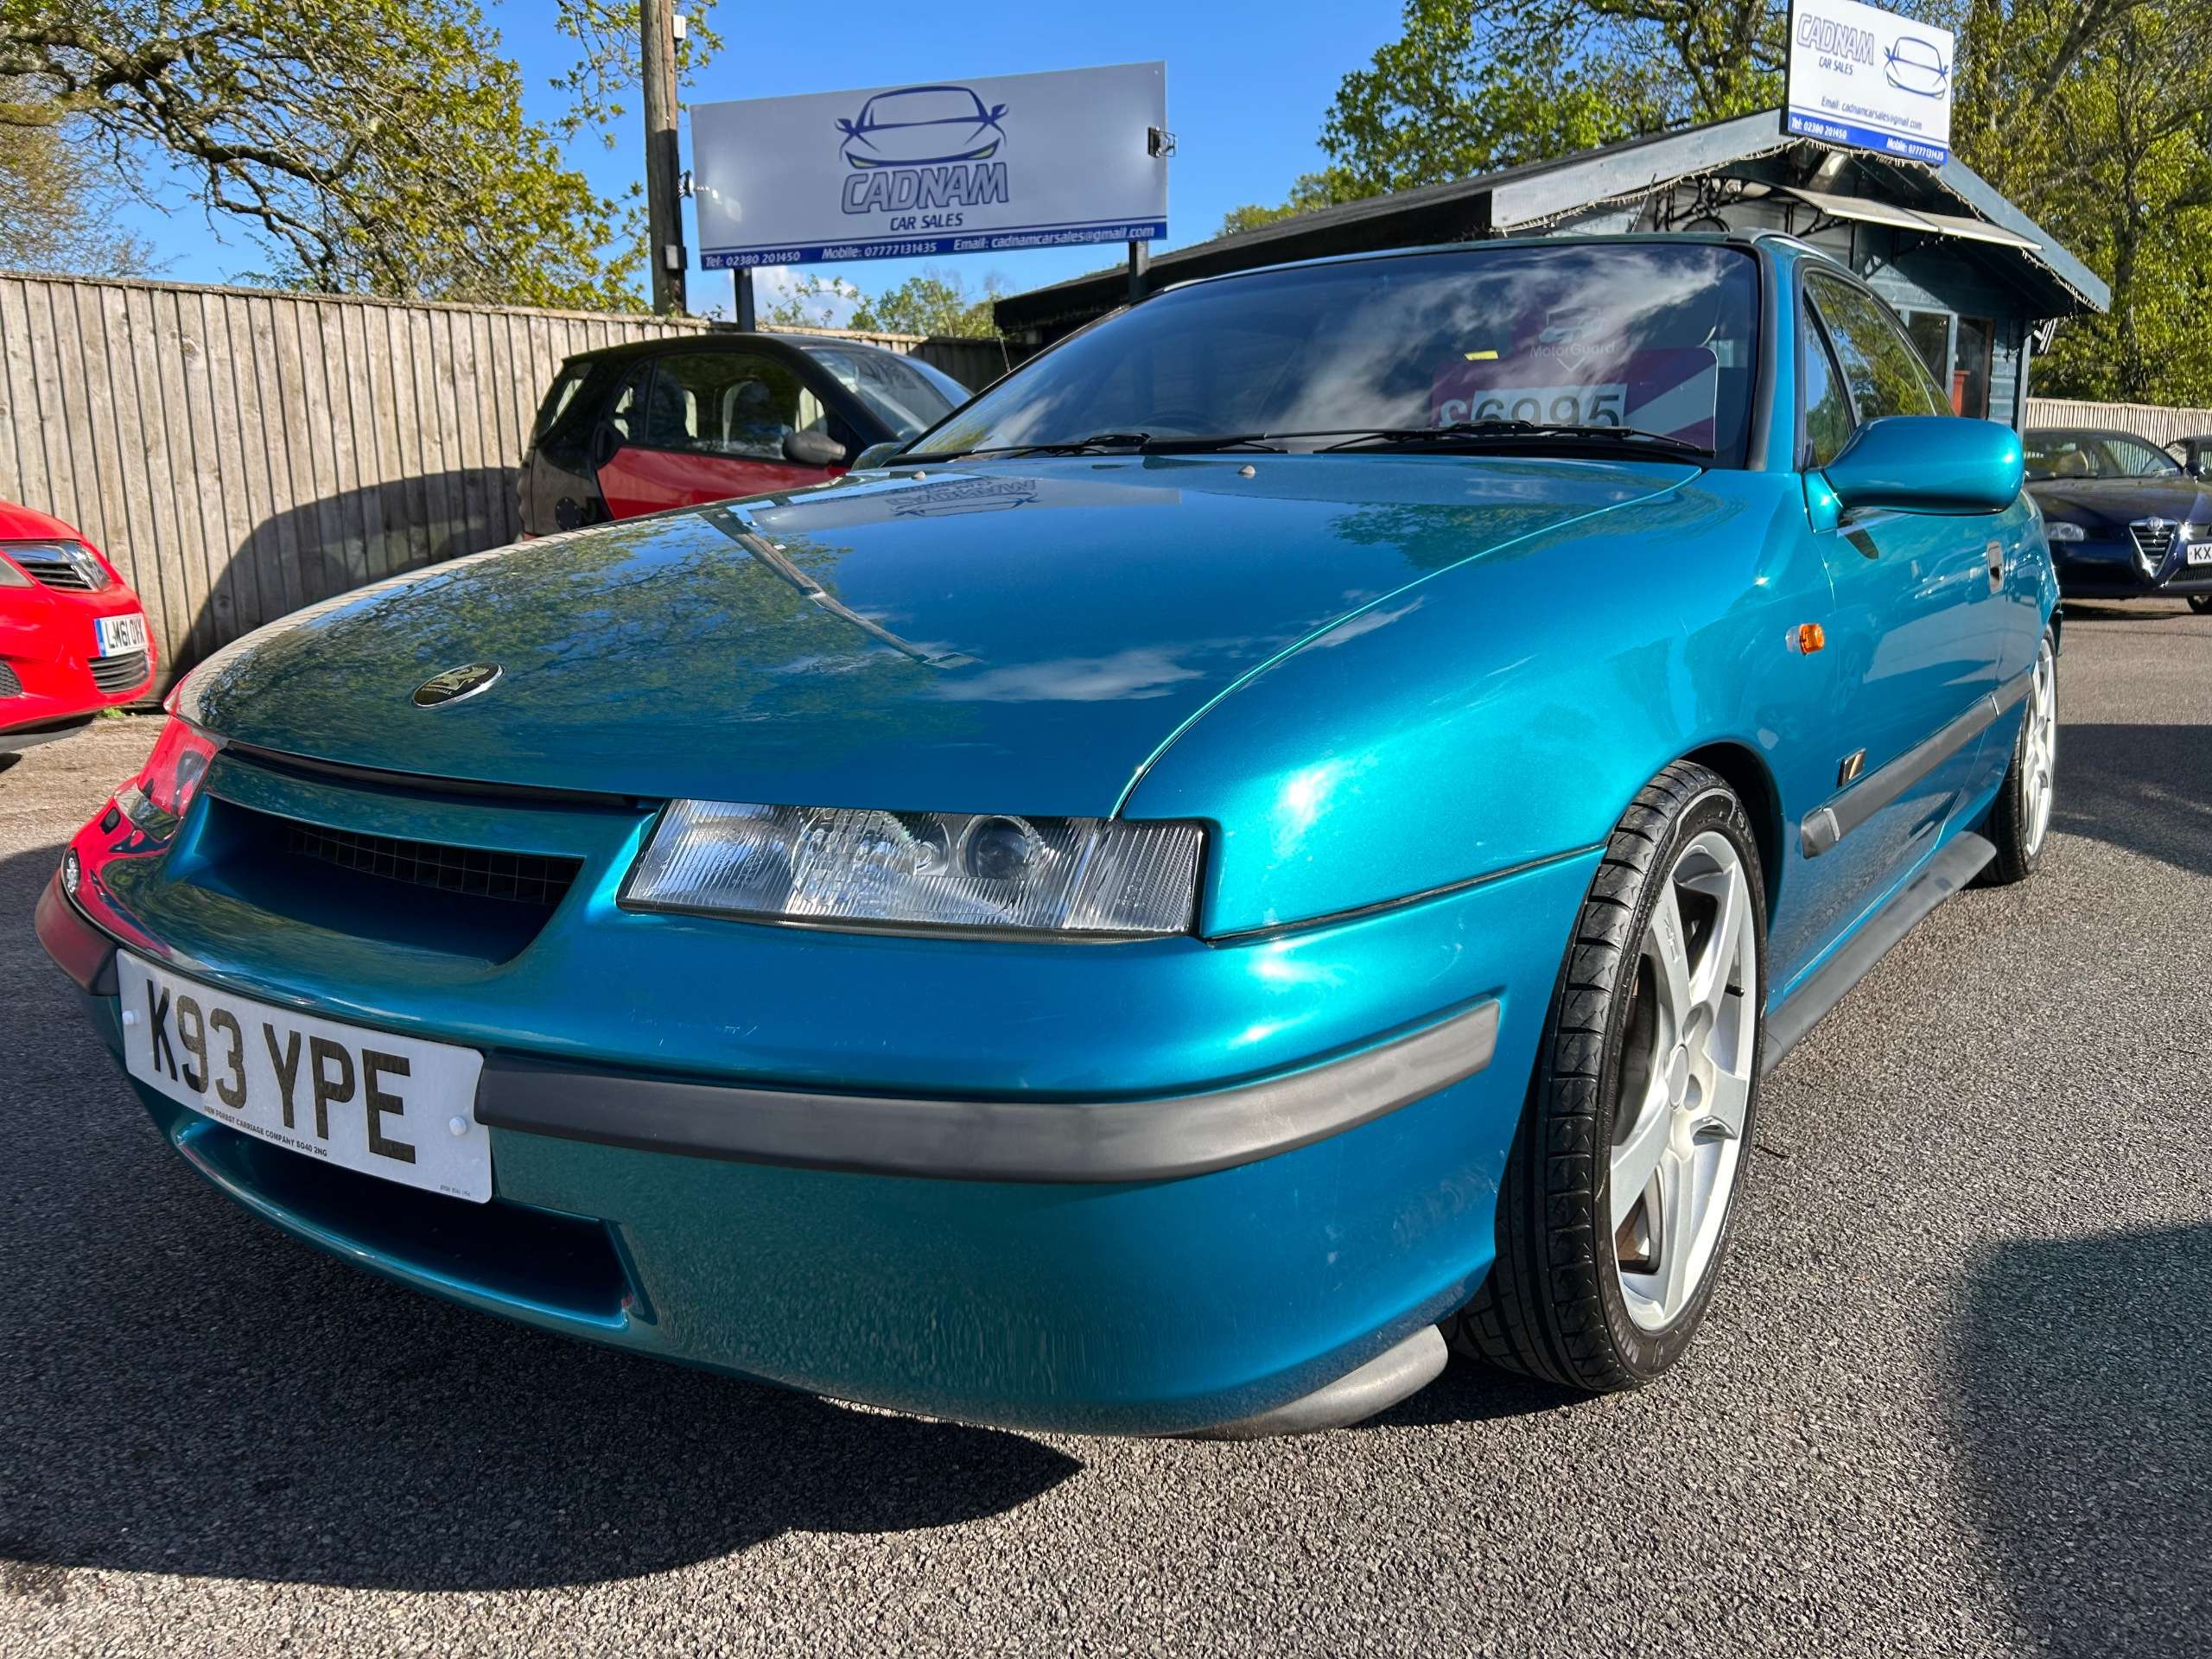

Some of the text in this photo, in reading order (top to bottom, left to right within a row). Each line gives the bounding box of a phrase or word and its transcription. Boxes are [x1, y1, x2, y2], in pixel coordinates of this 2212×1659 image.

[1796, 13, 1875, 67] CADNAM
[1818, 56, 1853, 76] CAR SALES
[842, 162, 1009, 215] CADNAM
[890, 213, 963, 232] CAR SALES
[726, 256, 760, 266] 02380
[761, 251, 801, 264] 201450
[822, 246, 862, 259] Mobile:
[864, 242, 938, 257] 07777131435
[953, 238, 989, 251] Email:
[991, 226, 1155, 248] cadnamcarsales@gmail.com
[1529, 341, 1617, 359] MotorGuard
[146, 979, 416, 1165] K93 YPE
[215, 1109, 235, 1124] FOREST
[236, 1118, 264, 1135] CARRIAGE
[265, 1129, 295, 1147] COMPANY
